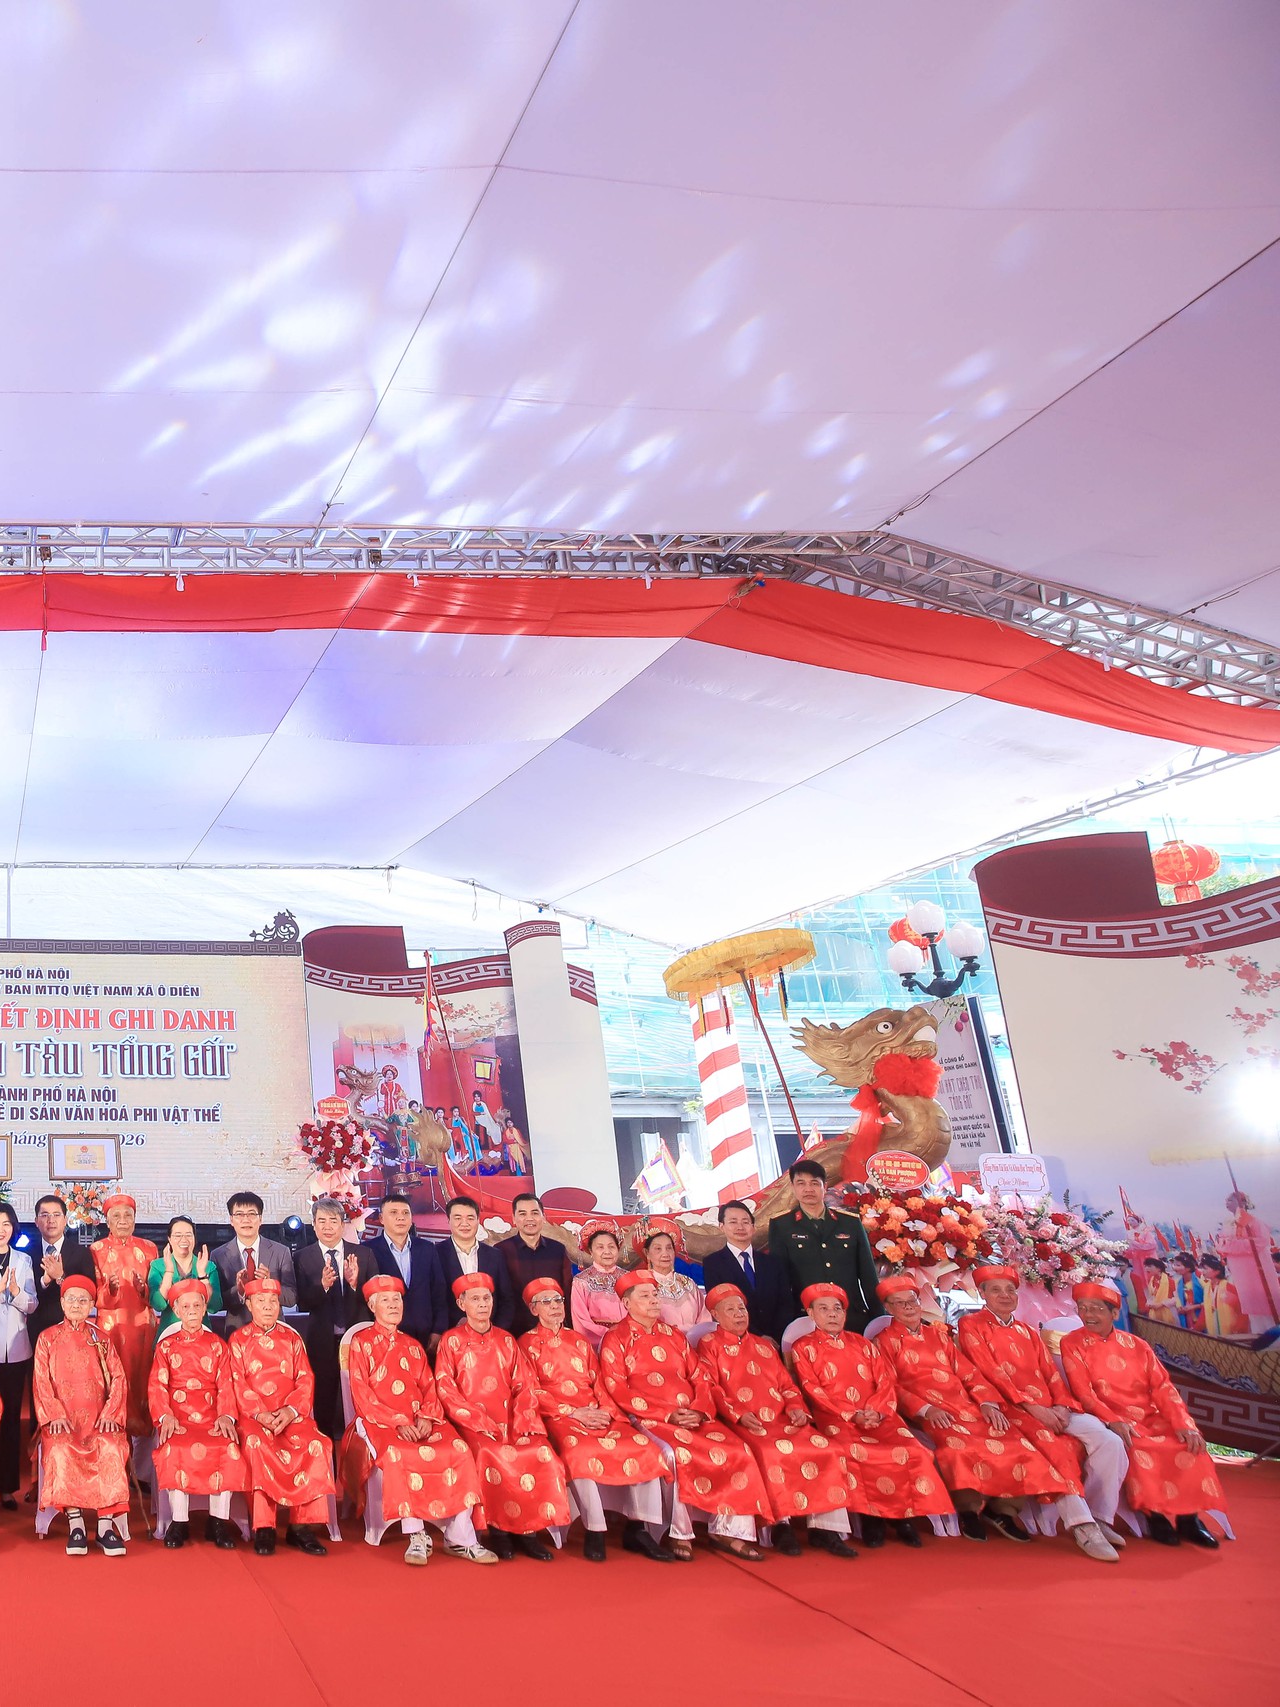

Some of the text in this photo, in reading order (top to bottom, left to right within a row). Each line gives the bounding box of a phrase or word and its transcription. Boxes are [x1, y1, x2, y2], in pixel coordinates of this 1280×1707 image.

[26, 968, 44, 980] HÀ
[47, 968, 70, 981] NỘI
[5, 985, 32, 995] BAN
[35, 985, 69, 997] MTTQ
[72, 983, 100, 998] VIỆT
[103, 985, 133, 997] NAM
[137, 983, 154, 997] XÃ
[157, 983, 167, 997] Ô
[170, 983, 200, 998] DIÊN
[36, 1008, 101, 1033] ĐỊNH
[108, 1008, 155, 1031] GHI
[163, 1009, 236, 1031] DANH
[16, 1036, 82, 1077] TÀU
[92, 1035, 175, 1078] TỔNG
[184, 1036, 235, 1079] GỐI"
[33, 1084, 62, 1102] PHỐ
[66, 1086, 86, 1102] HÀ
[91, 1087, 117, 1105] NỘI
[10, 1107, 25, 1121] DI
[29, 1103, 59, 1121] SẢN
[64, 1104, 94, 1121] VĂN
[99, 1104, 128, 1122] HOÁ
[133, 1108, 157, 1122] PHI
[162, 1104, 189, 1124] VẬT
[194, 1103, 221, 1122] THỂ
[6, 1131, 47, 1148] háng
